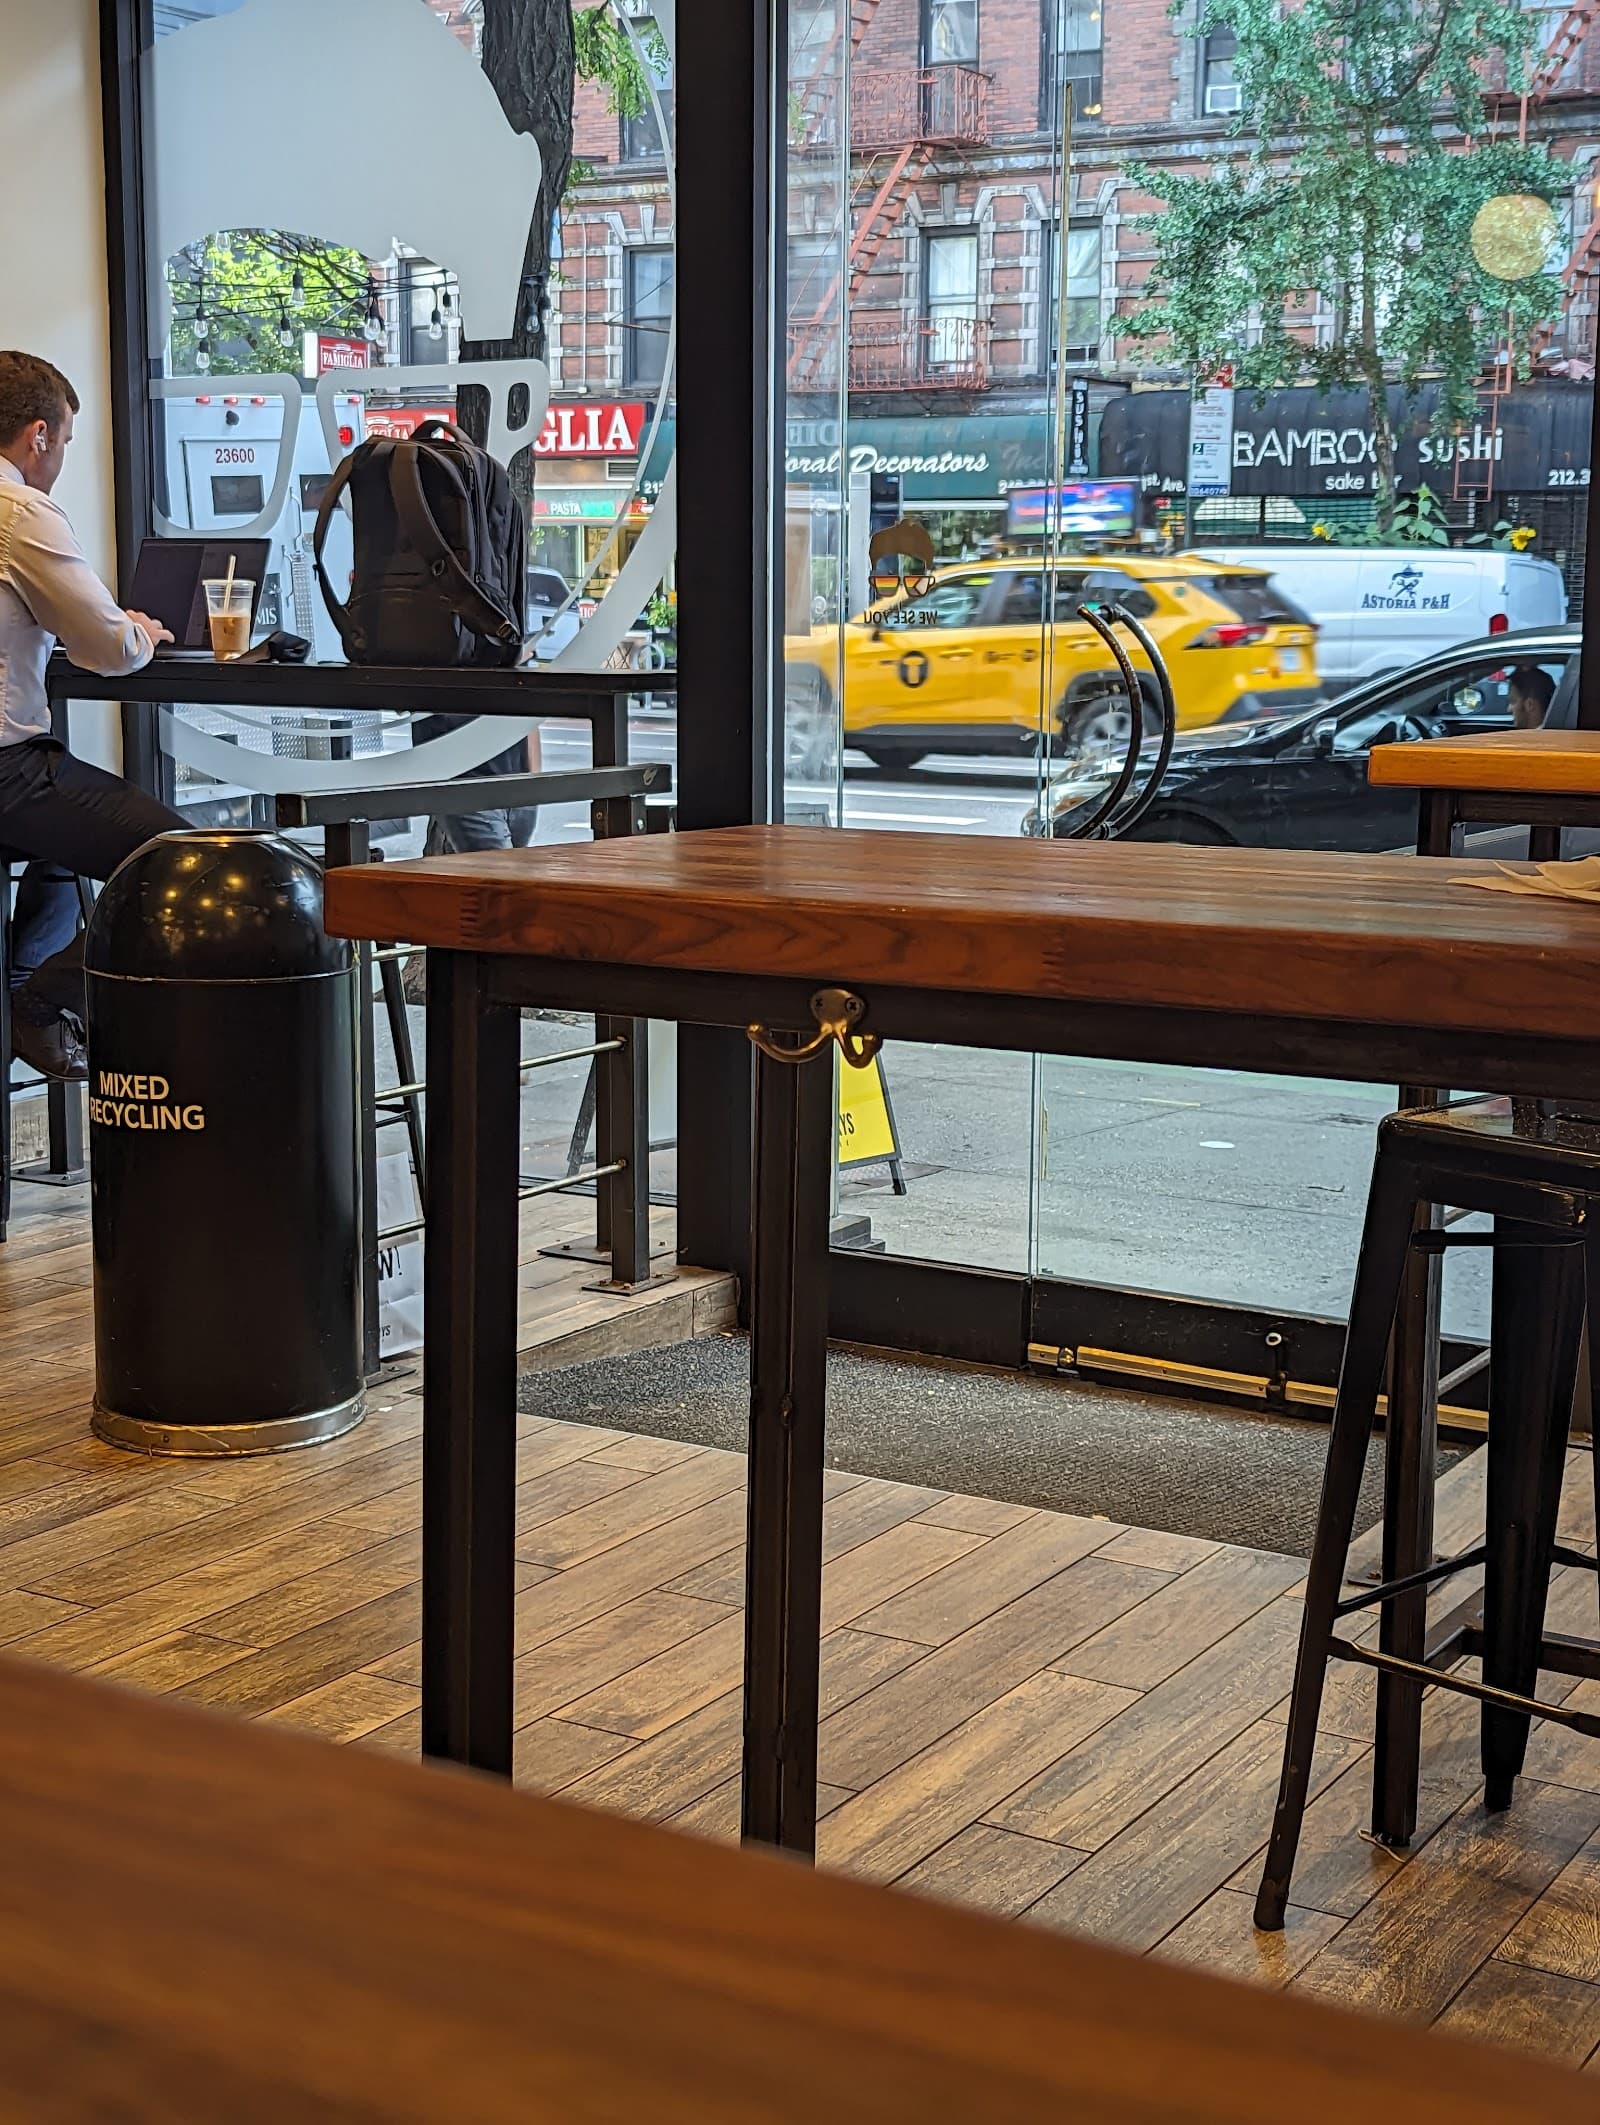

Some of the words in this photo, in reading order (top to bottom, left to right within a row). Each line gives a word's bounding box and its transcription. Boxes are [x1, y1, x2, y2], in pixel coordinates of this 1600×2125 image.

[322, 350, 364, 369] FAMIGLIA
[215, 448, 255, 464] 23600
[785, 446, 840, 472] oral
[850, 445, 989, 473] Decorators
[1325, 470, 1365, 490] sake
[1371, 470, 1403, 490] br
[550, 502, 582, 515] PASTA
[1361, 593, 1417, 609] ASTORIA
[1422, 594, 1450, 609] P&H
[99, 1070, 170, 1100] MIXED
[89, 1096, 206, 1130] RECYCLING
